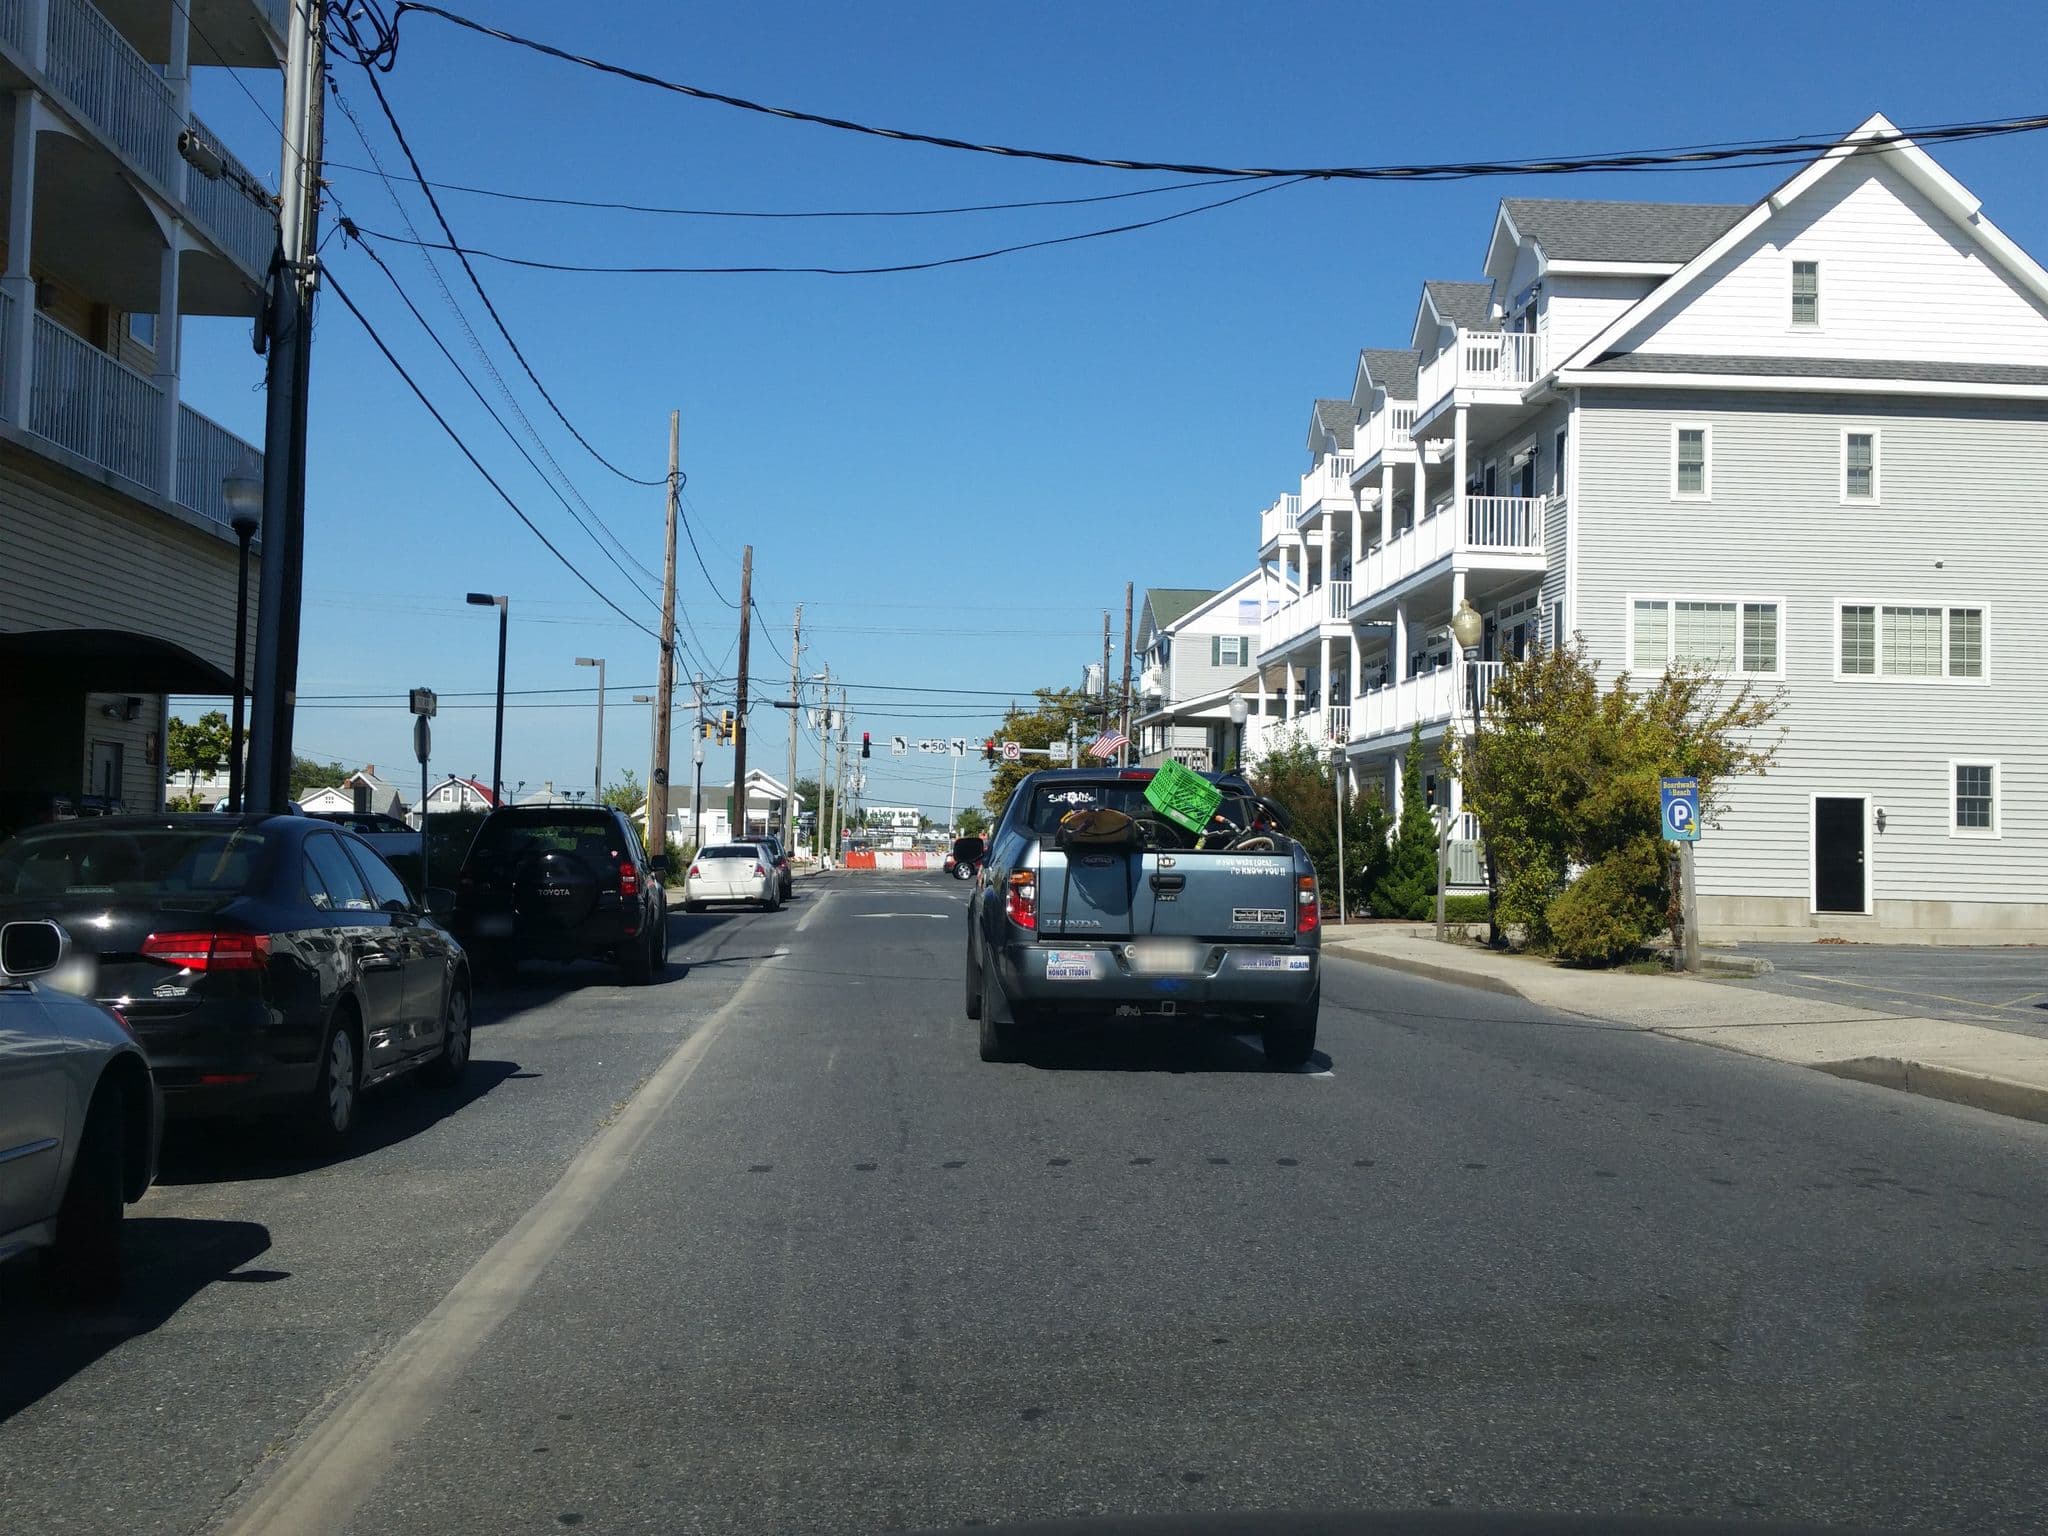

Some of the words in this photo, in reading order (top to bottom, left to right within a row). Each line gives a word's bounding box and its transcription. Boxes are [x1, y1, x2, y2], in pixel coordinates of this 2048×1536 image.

[932, 742, 945, 751] 50
[1663, 781, 1696, 789] Boardwalk
[1673, 788, 1691, 796] Beach
[1674, 805, 1688, 827] P
[1222, 858, 1235, 866] YOU
[1242, 867, 1263, 875] KNOW
[538, 888, 570, 896] TOYOTA
[1260, 959, 1281, 967] STUDENT
[1290, 961, 1309, 969] AGAIN
[1049, 968, 1067, 976] HONOR
[1069, 969, 1091, 977] STUDENT
